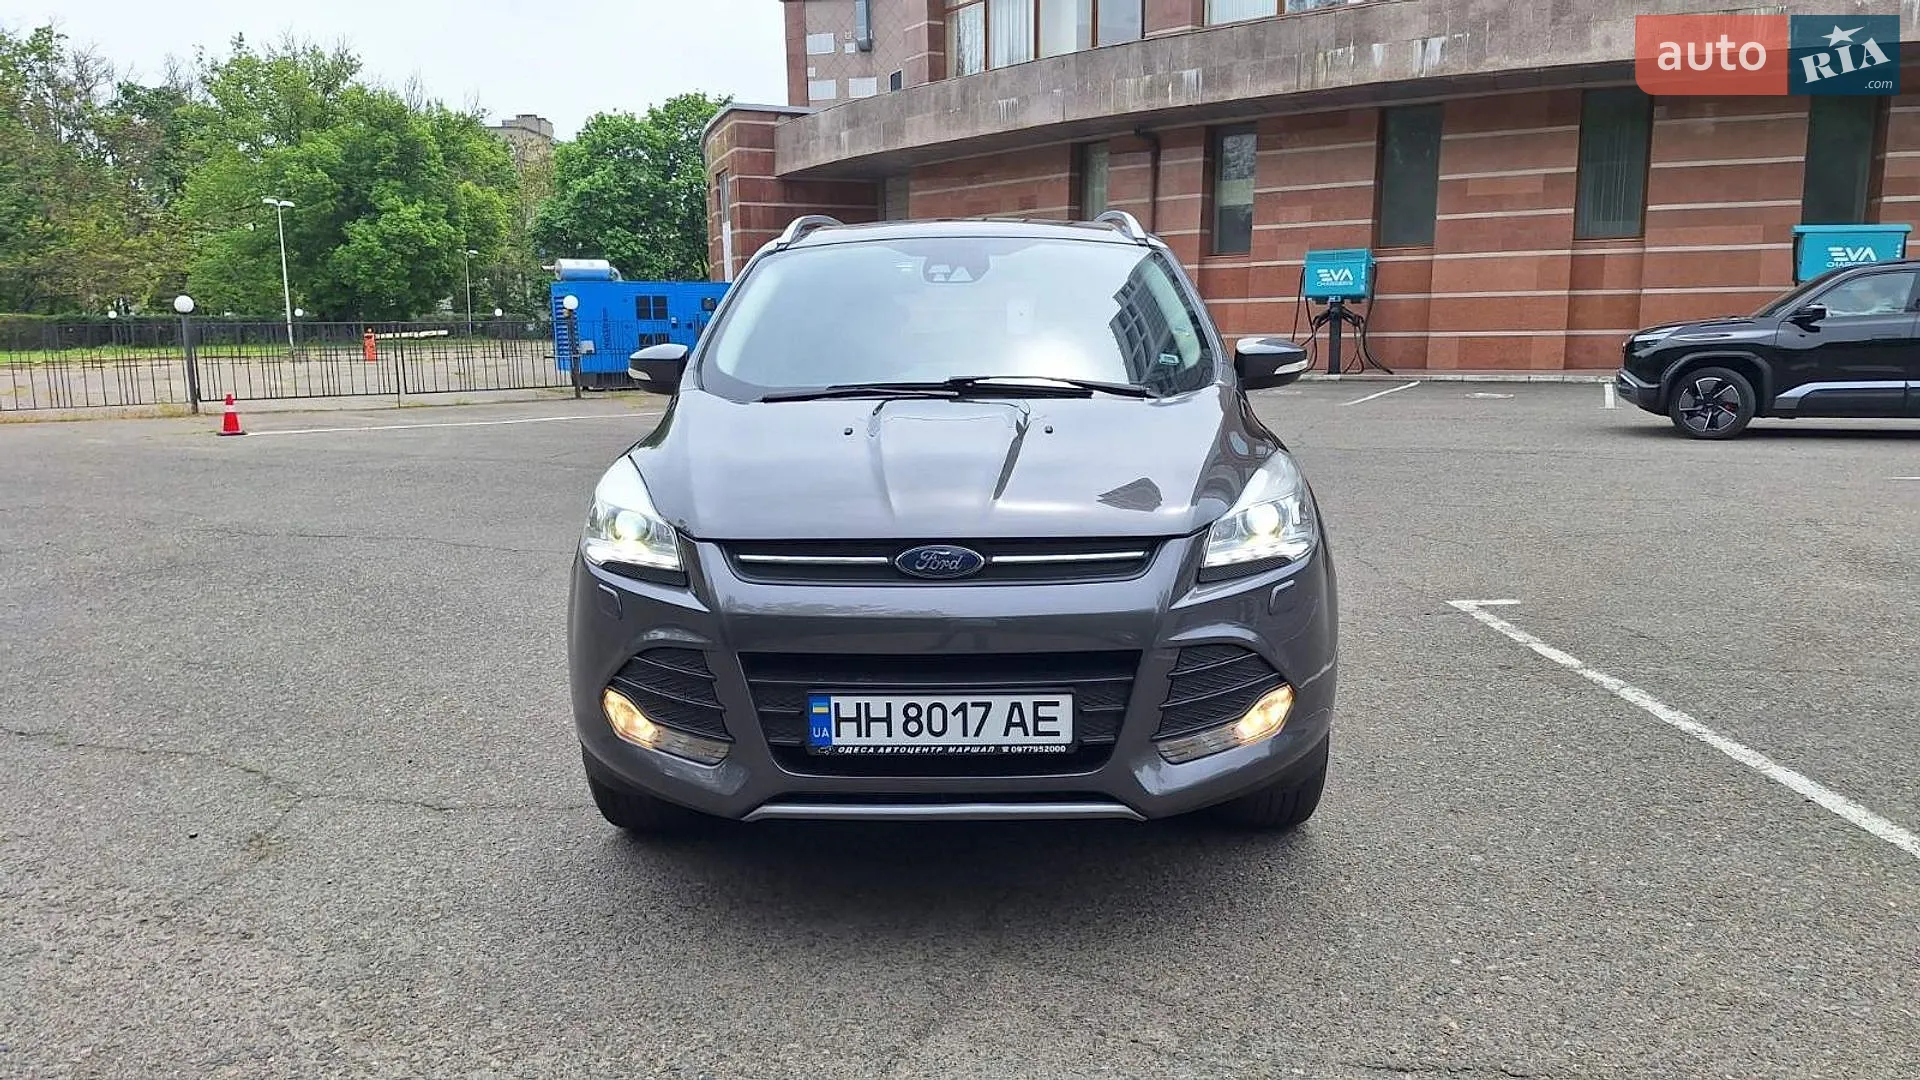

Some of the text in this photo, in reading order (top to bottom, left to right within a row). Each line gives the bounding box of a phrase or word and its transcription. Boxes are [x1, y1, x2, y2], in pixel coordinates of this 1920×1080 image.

[1827, 246, 1877, 262] EVA
[1316, 268, 1354, 281] EVA
[915, 550, 964, 570] Ford
[834, 700, 1061, 738] HH 8017 AE
[812, 727, 830, 738] UA
[838, 746, 875, 754] ОДЕСА
[875, 746, 944, 754] АВТОЦЕНТР
